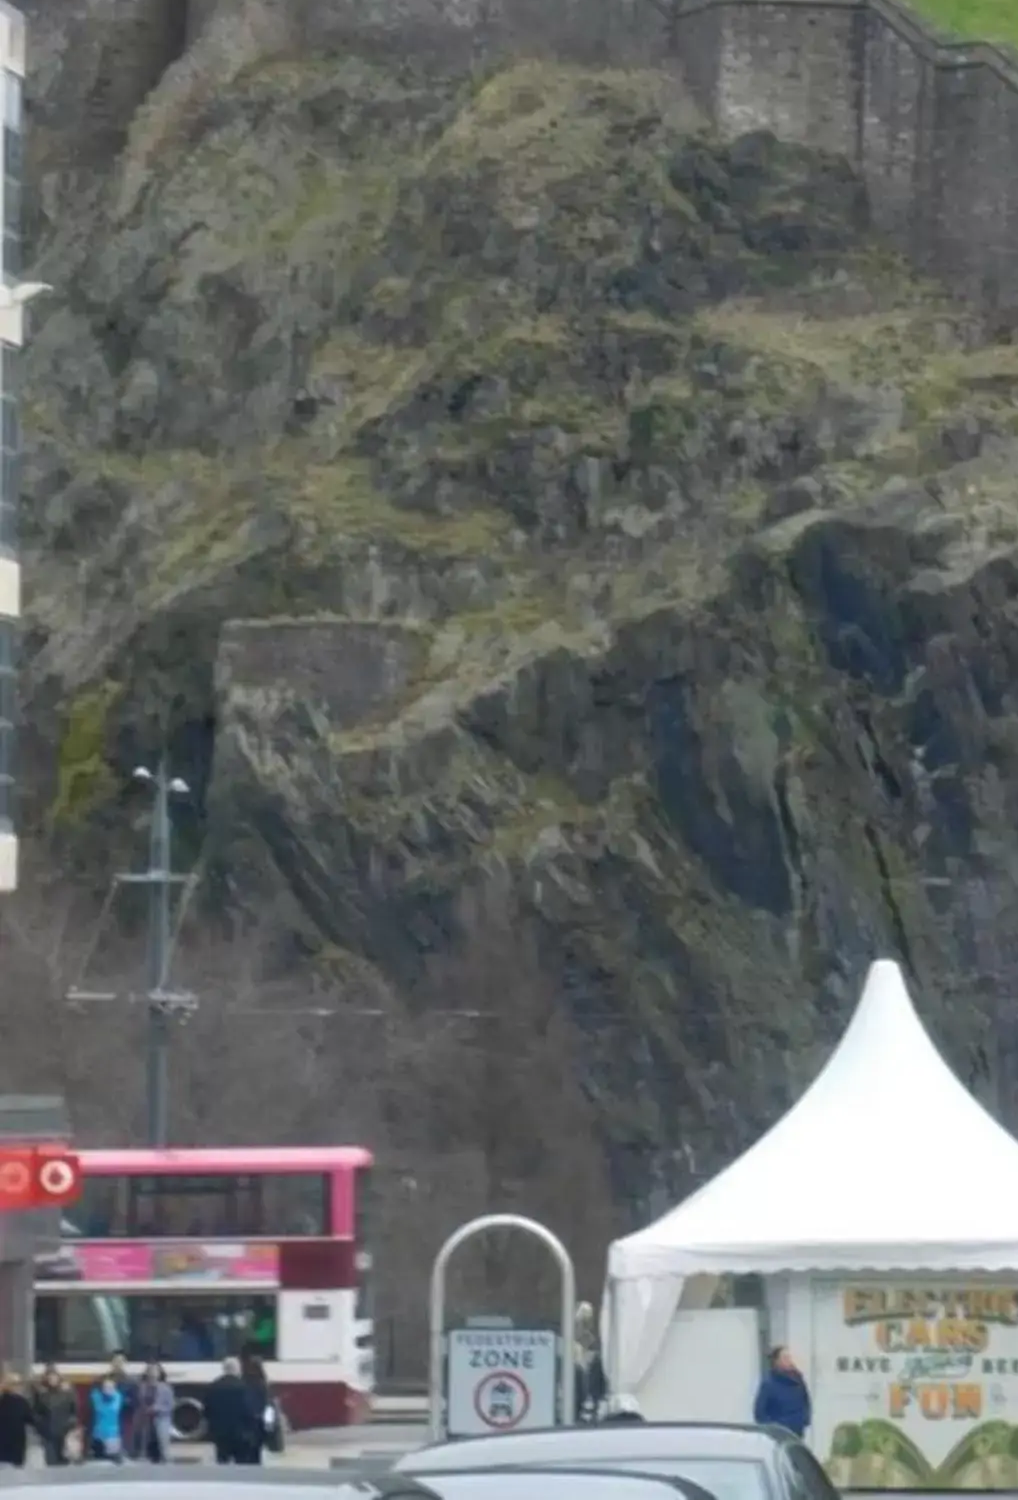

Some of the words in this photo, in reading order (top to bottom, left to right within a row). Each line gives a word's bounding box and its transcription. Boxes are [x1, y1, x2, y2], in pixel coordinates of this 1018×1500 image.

[875, 1317, 989, 1353] CARS
[468, 1349, 536, 1369] ZONE
[836, 1356, 892, 1373] HAVE
[888, 1380, 983, 1421] FUN
